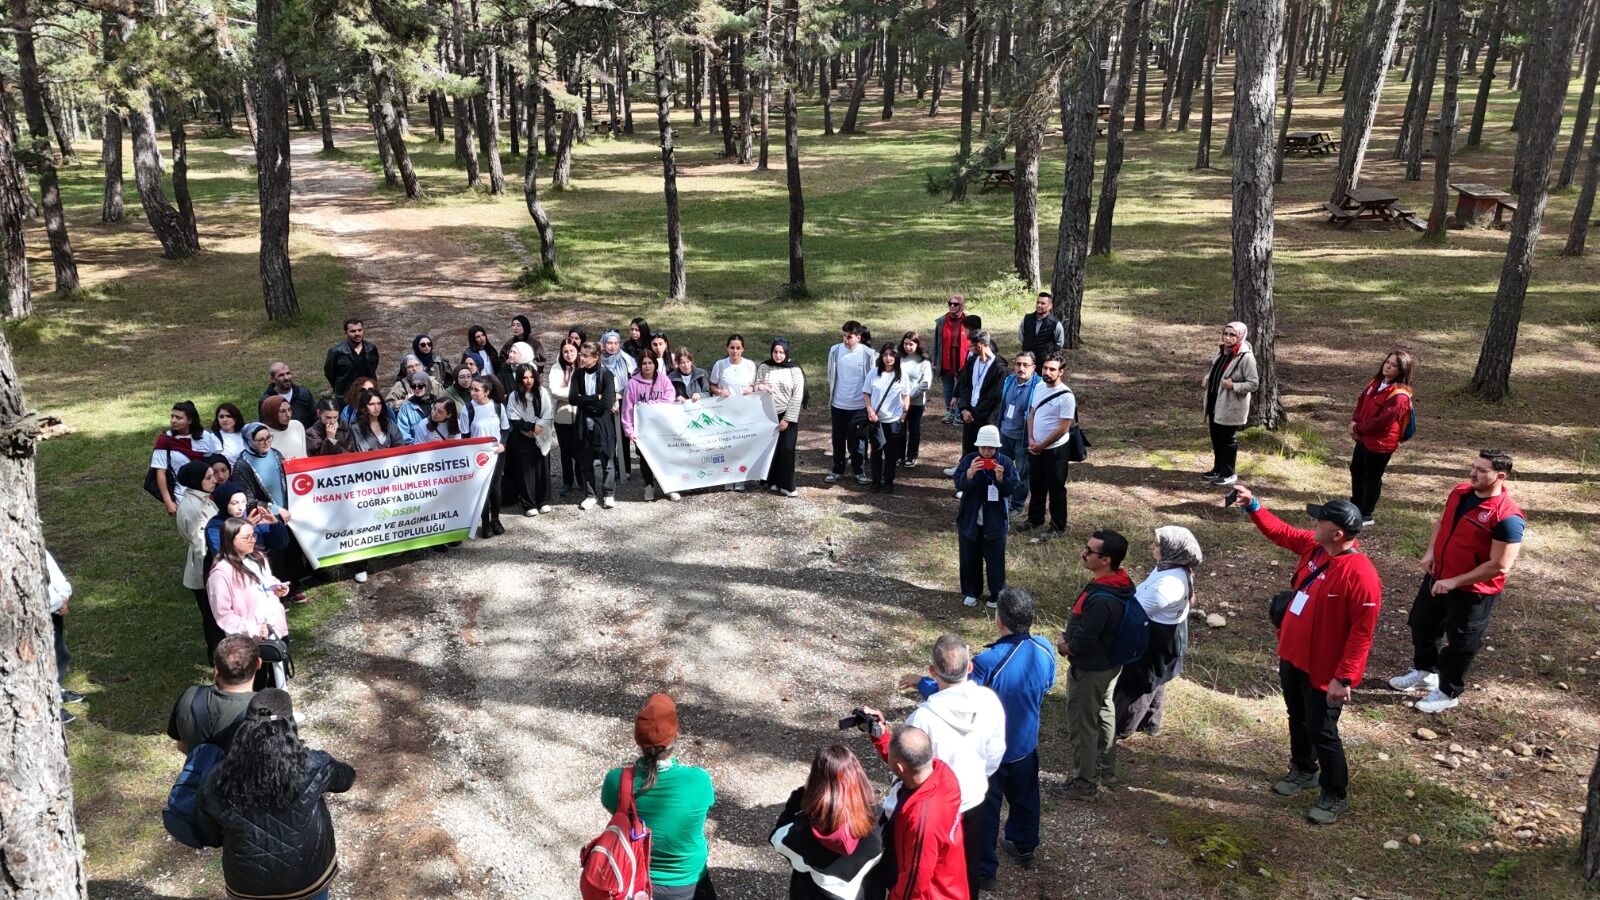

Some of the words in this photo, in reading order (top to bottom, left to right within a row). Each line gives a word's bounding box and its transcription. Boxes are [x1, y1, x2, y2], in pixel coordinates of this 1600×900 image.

[317, 469, 390, 489] KASTAMONU
[392, 456, 470, 478] ÜNİVERSİTESİ
[313, 493, 342, 503] İNSAN
[343, 491, 355, 499] VE
[357, 486, 389, 498] TOPLUM
[391, 478, 431, 492] BİLİMLERİ
[433, 471, 475, 487] FAKÜLTESİ
[357, 495, 402, 509] COĞRAFYA
[404, 488, 438, 502] BÖLÜMÜ
[391, 505, 421, 517] DSBM
[325, 528, 354, 540] DOĞA
[356, 524, 381, 536] SPOR
[384, 521, 396, 530] VE
[339, 532, 390, 549] MÜCADELE
[392, 523, 446, 539] TOPLULUĞU
